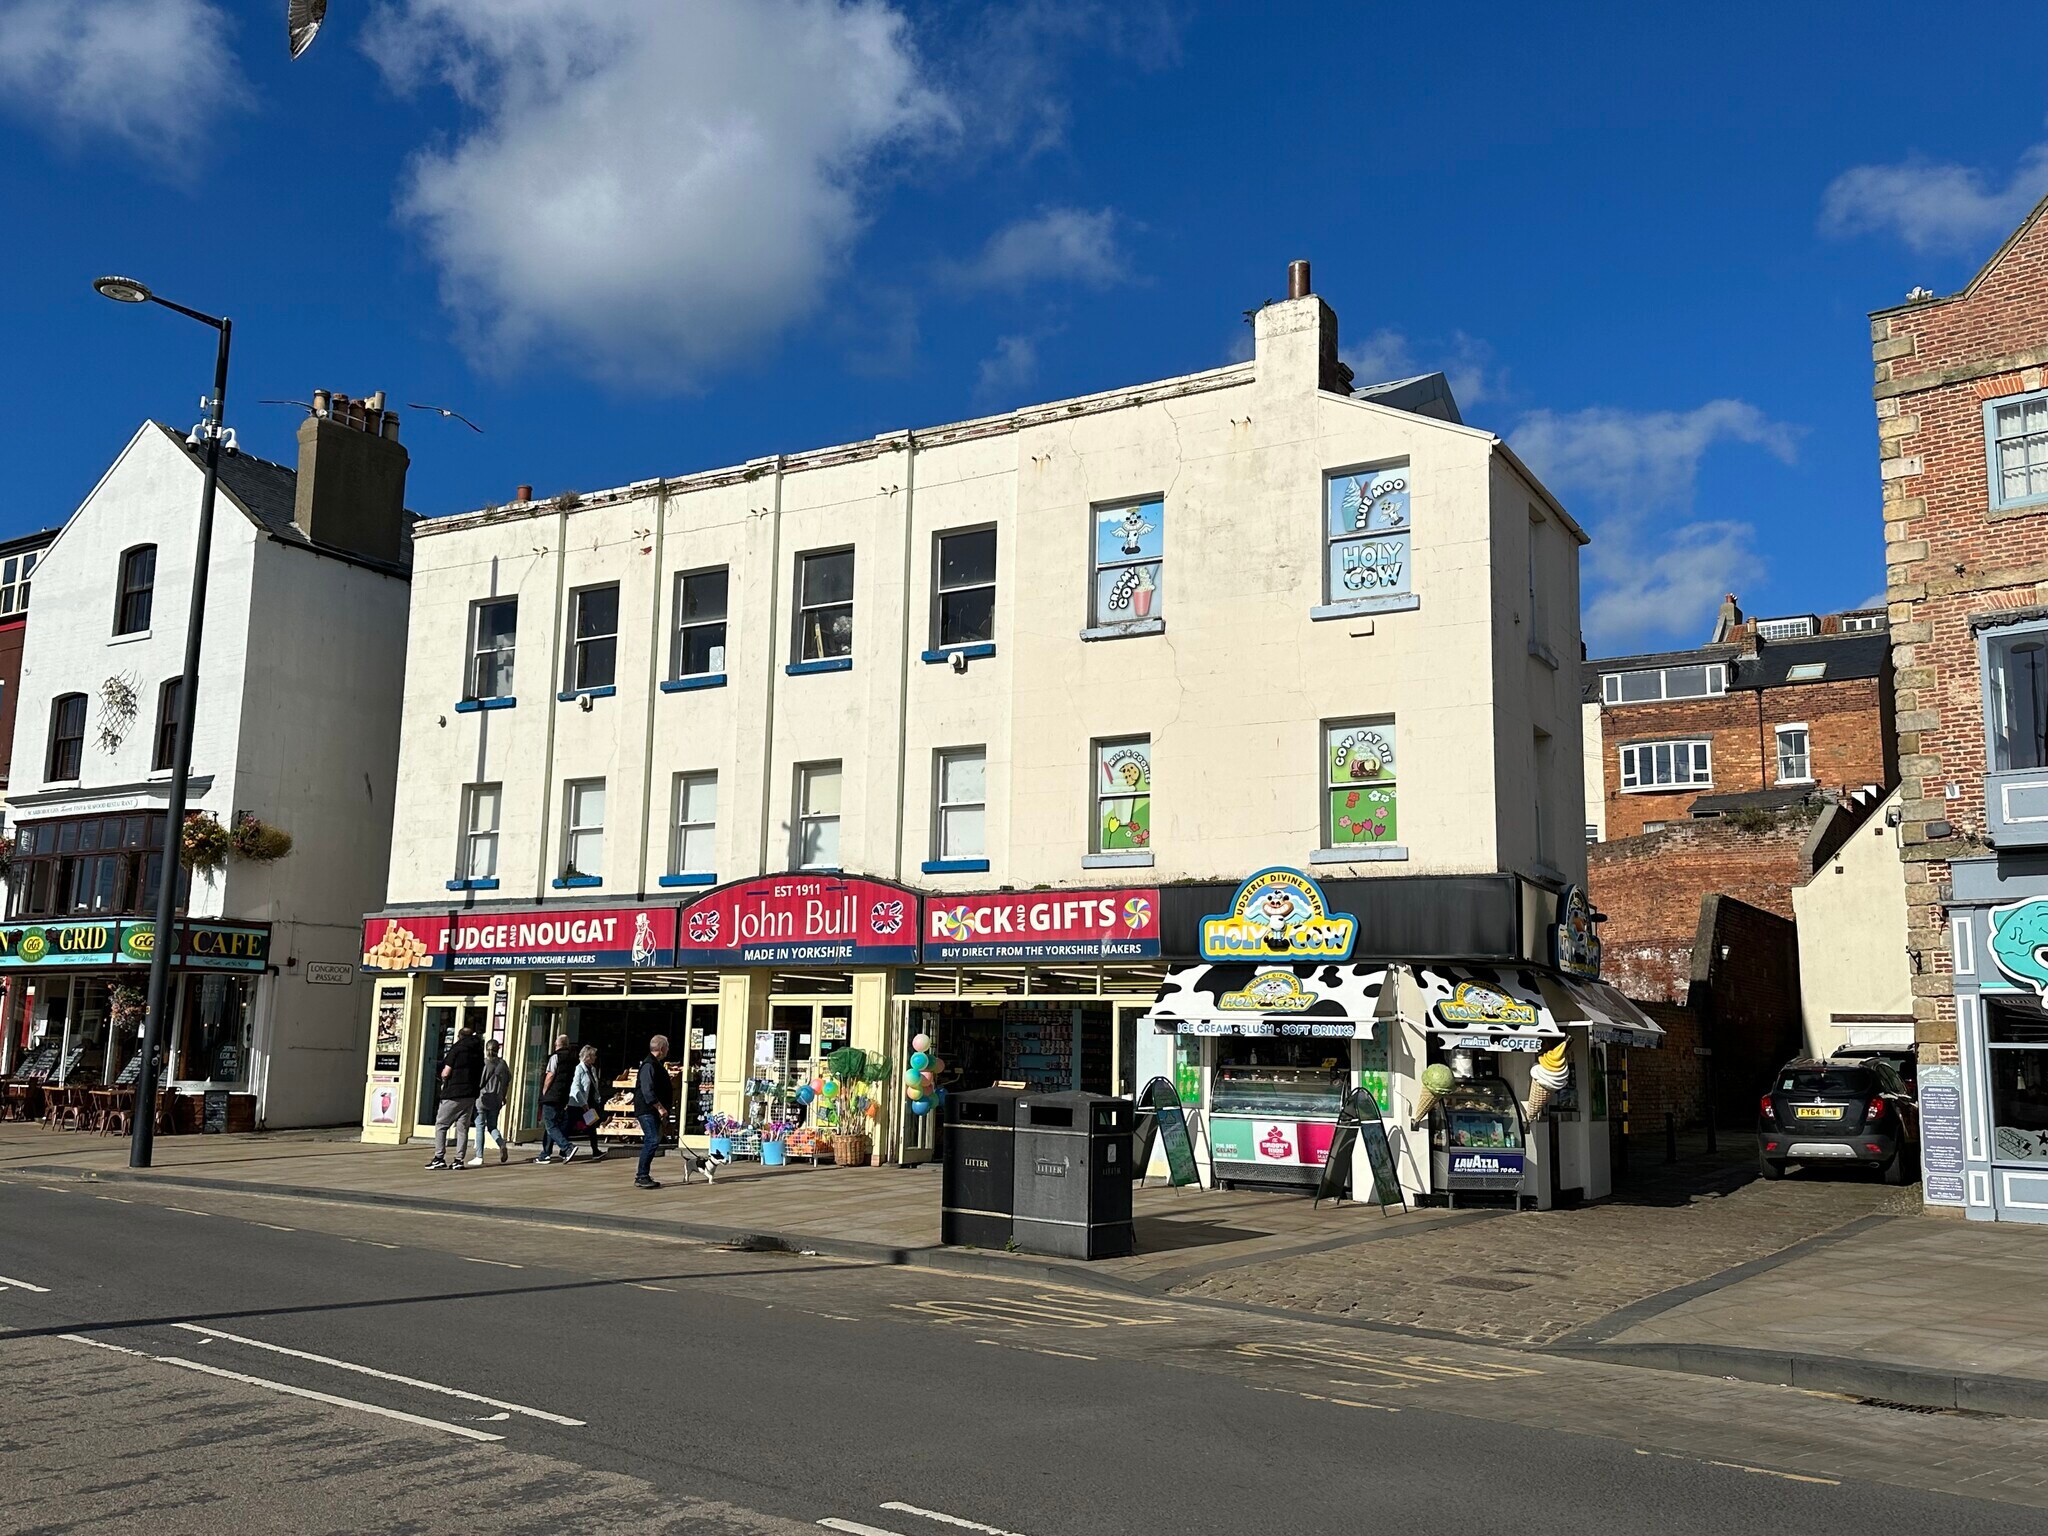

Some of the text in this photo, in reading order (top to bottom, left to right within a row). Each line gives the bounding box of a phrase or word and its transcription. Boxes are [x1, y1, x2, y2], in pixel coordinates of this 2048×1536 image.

[1355, 478, 1405, 529] BLUE MOO
[1342, 542, 1404, 570] HOLY
[1343, 562, 1403, 591] COW
[1108, 566, 1136, 610] CREAMY
[1118, 573, 1141, 609] COW
[1335, 731, 1393, 767] COW PAT PIE
[1108, 750, 1125, 767] MILK
[1132, 751, 1151, 784] COOKIES
[775, 884, 820, 897] EST 1911
[1236, 874, 1323, 917] UDDERLY DIVINE DAIRY
[727, 896, 857, 947] John Bull
[1017, 904, 1026, 932] AND
[1029, 899, 1116, 931] GIFTS
[59, 927, 263, 956] GRID CAFE
[438, 917, 617, 952] FUDGE AND NOUGAT
[1209, 924, 1348, 950] HOLY COW
[744, 946, 852, 961] MADE IN YORKSHIRE
[942, 944, 1141, 957] BUY DIRECT FROM THE YORKSHIRE MAKERS
[310, 965, 350, 973] LONGROOM
[454, 957, 467, 966] BUY
[469, 957, 490, 965] DIRECT
[513, 956, 526, 964] THE
[528, 955, 565, 964] YORKSHIRE
[567, 955, 596, 964] MAKERS
[315, 973, 344, 982] PASSAGE
[195, 984, 221, 993] CAFE
[1223, 995, 1309, 1008] HOLY COW
[1445, 1004, 1532, 1021] HOLY COW
[1178, 1023, 1354, 1036] ICE CREAM SLUSH SOFT DRINKS
[1501, 1039, 1542, 1049] COFFEE
[965, 1158, 989, 1168] LITTER
[1036, 1163, 1062, 1174] LITTER
[1454, 1155, 1499, 1168] LAVAZZA
